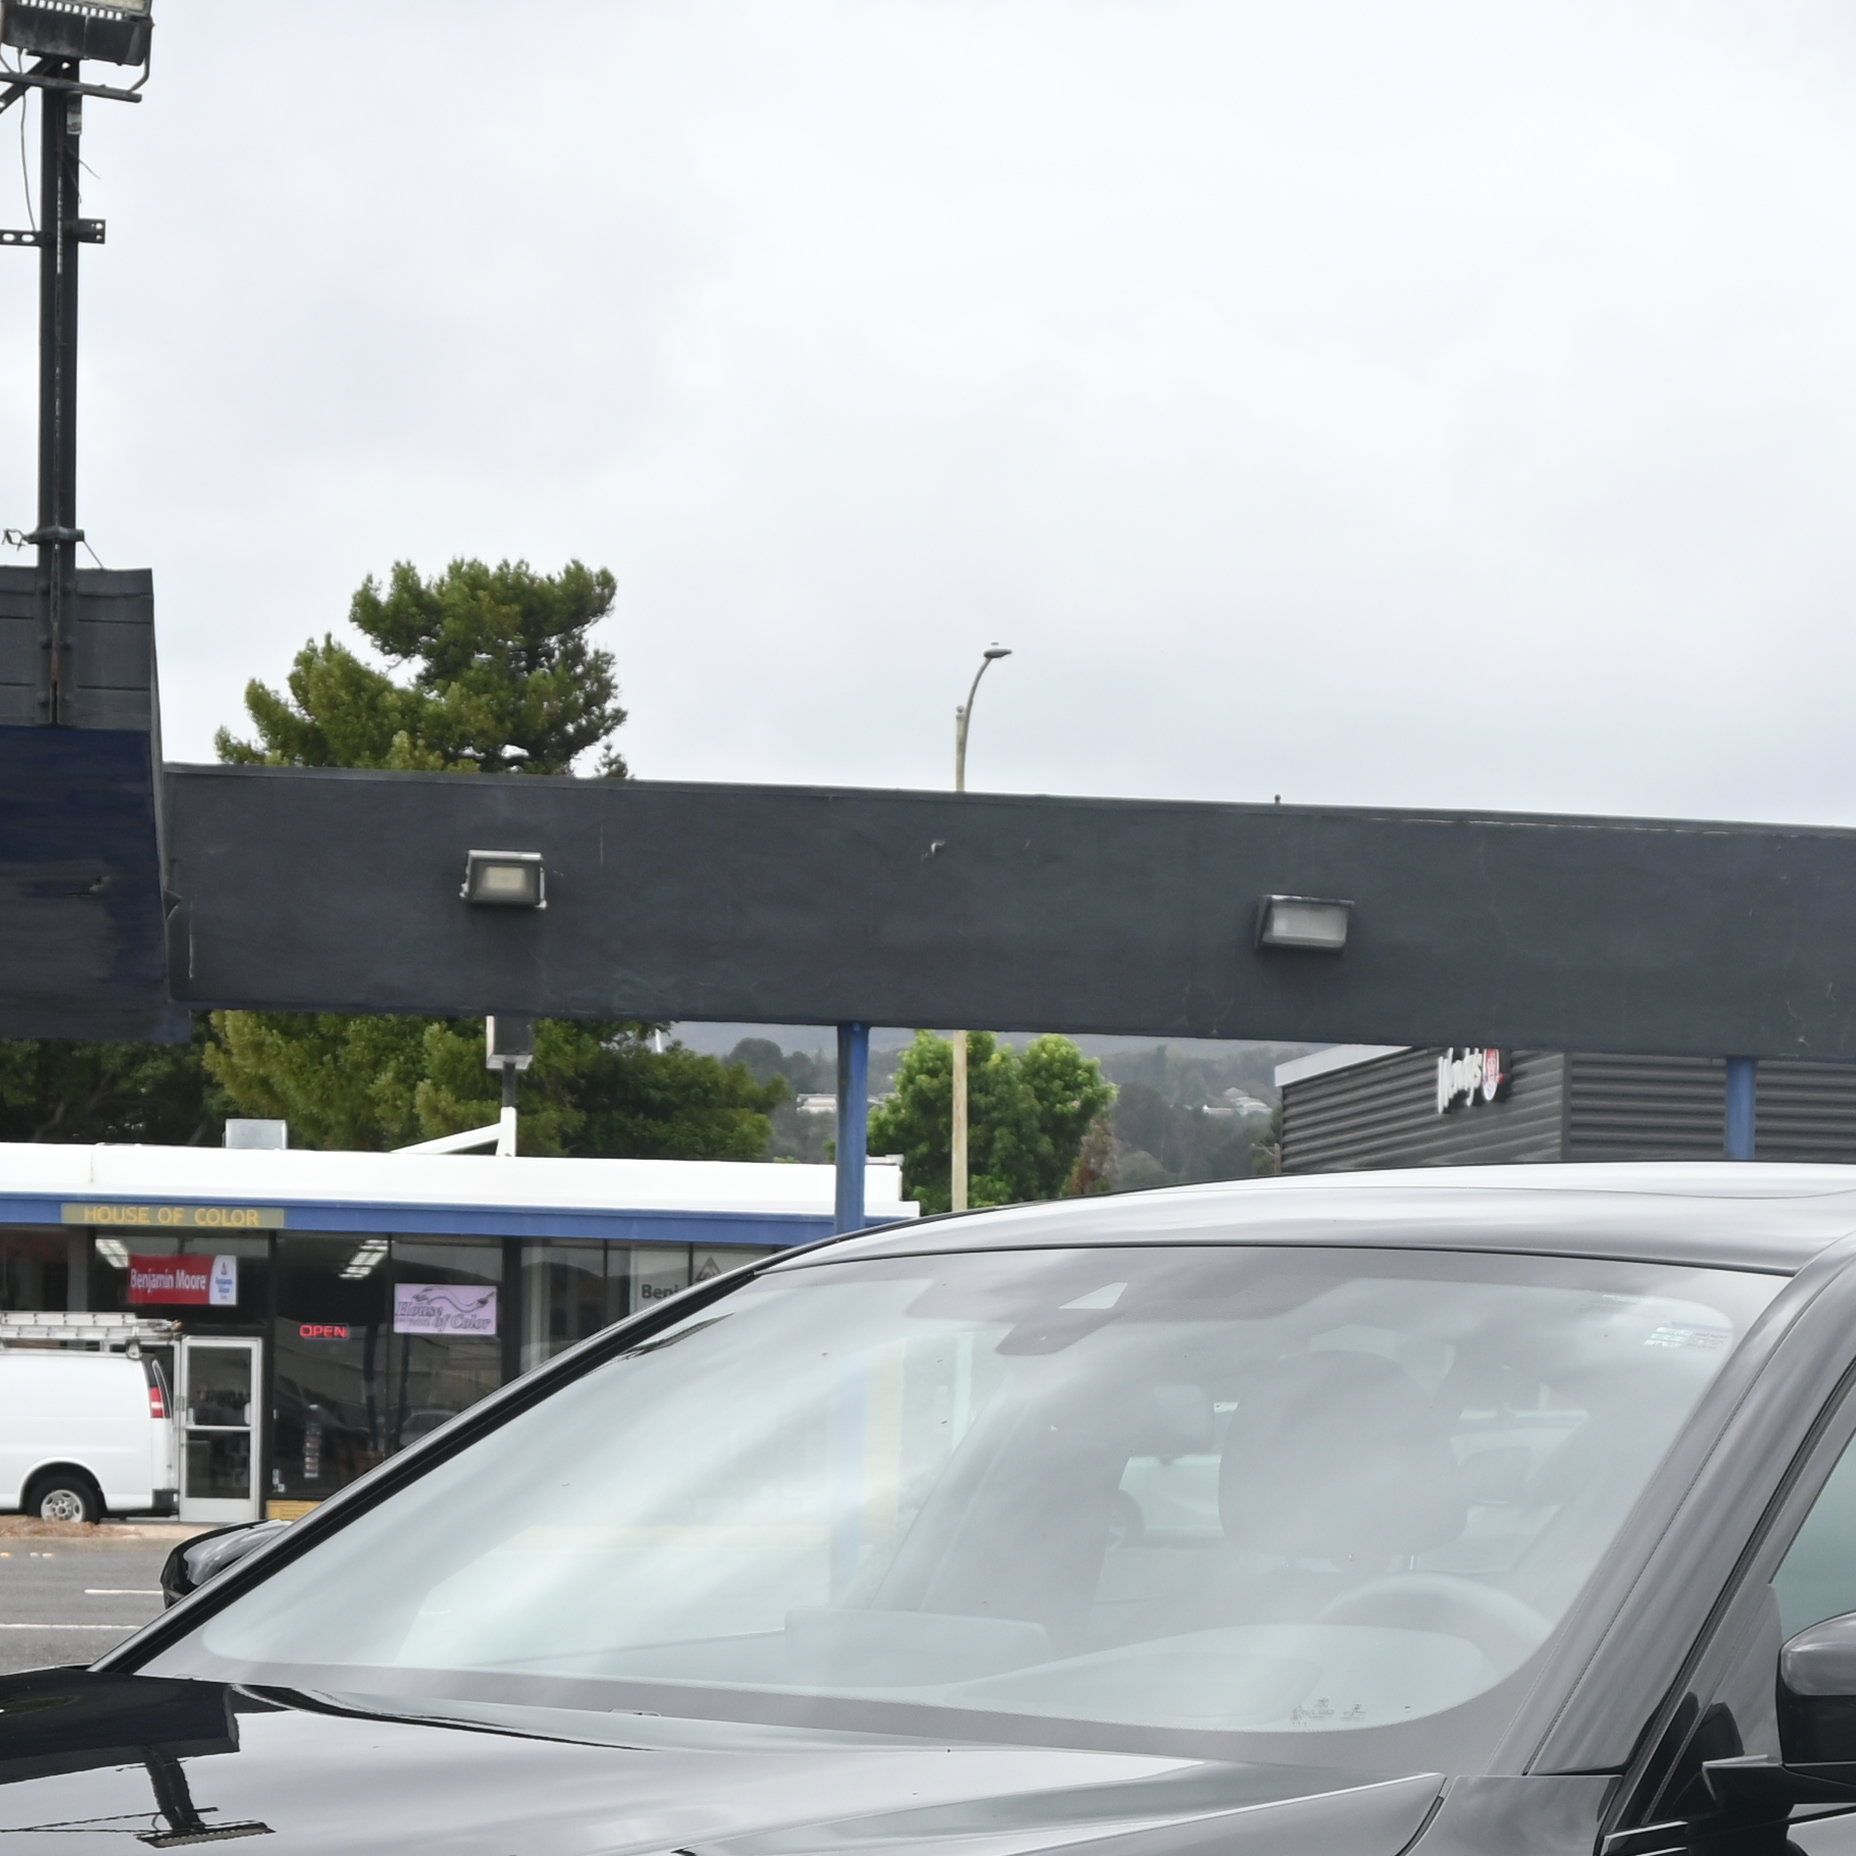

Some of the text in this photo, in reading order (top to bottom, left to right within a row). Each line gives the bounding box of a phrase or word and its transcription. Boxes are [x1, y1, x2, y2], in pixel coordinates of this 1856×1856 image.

[85, 1206, 260, 1226] HOUSE OF COLOR
[130, 1268, 174, 1293] Benjamin
[175, 1269, 207, 1290] Moore
[395, 1301, 443, 1317] House
[450, 1313, 491, 1330] Color
[298, 1323, 349, 1339] OPEN
